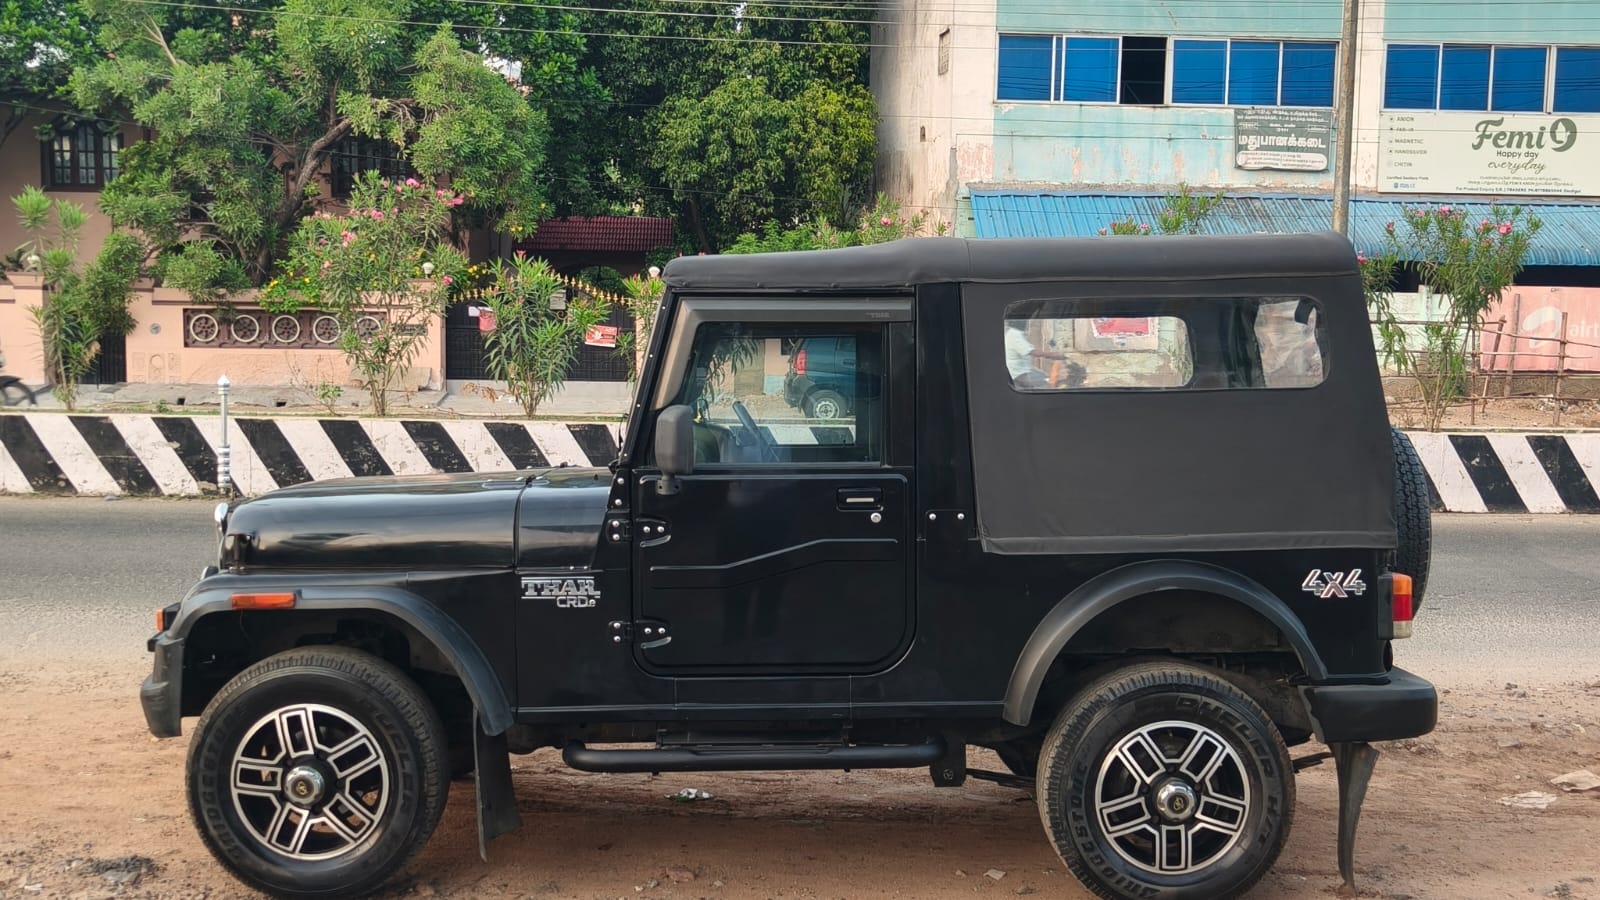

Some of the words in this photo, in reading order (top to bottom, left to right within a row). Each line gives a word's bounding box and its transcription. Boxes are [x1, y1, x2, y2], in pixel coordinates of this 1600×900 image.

[1238, 133, 1327, 151] மதுபானக்கடை
[1472, 117, 1547, 151] Femi
[1549, 118, 1577, 152] 9
[1497, 150, 1522, 159] Happy
[1524, 150, 1539, 159] day
[1487, 158, 1546, 175] everyday
[521, 576, 601, 596] THAR
